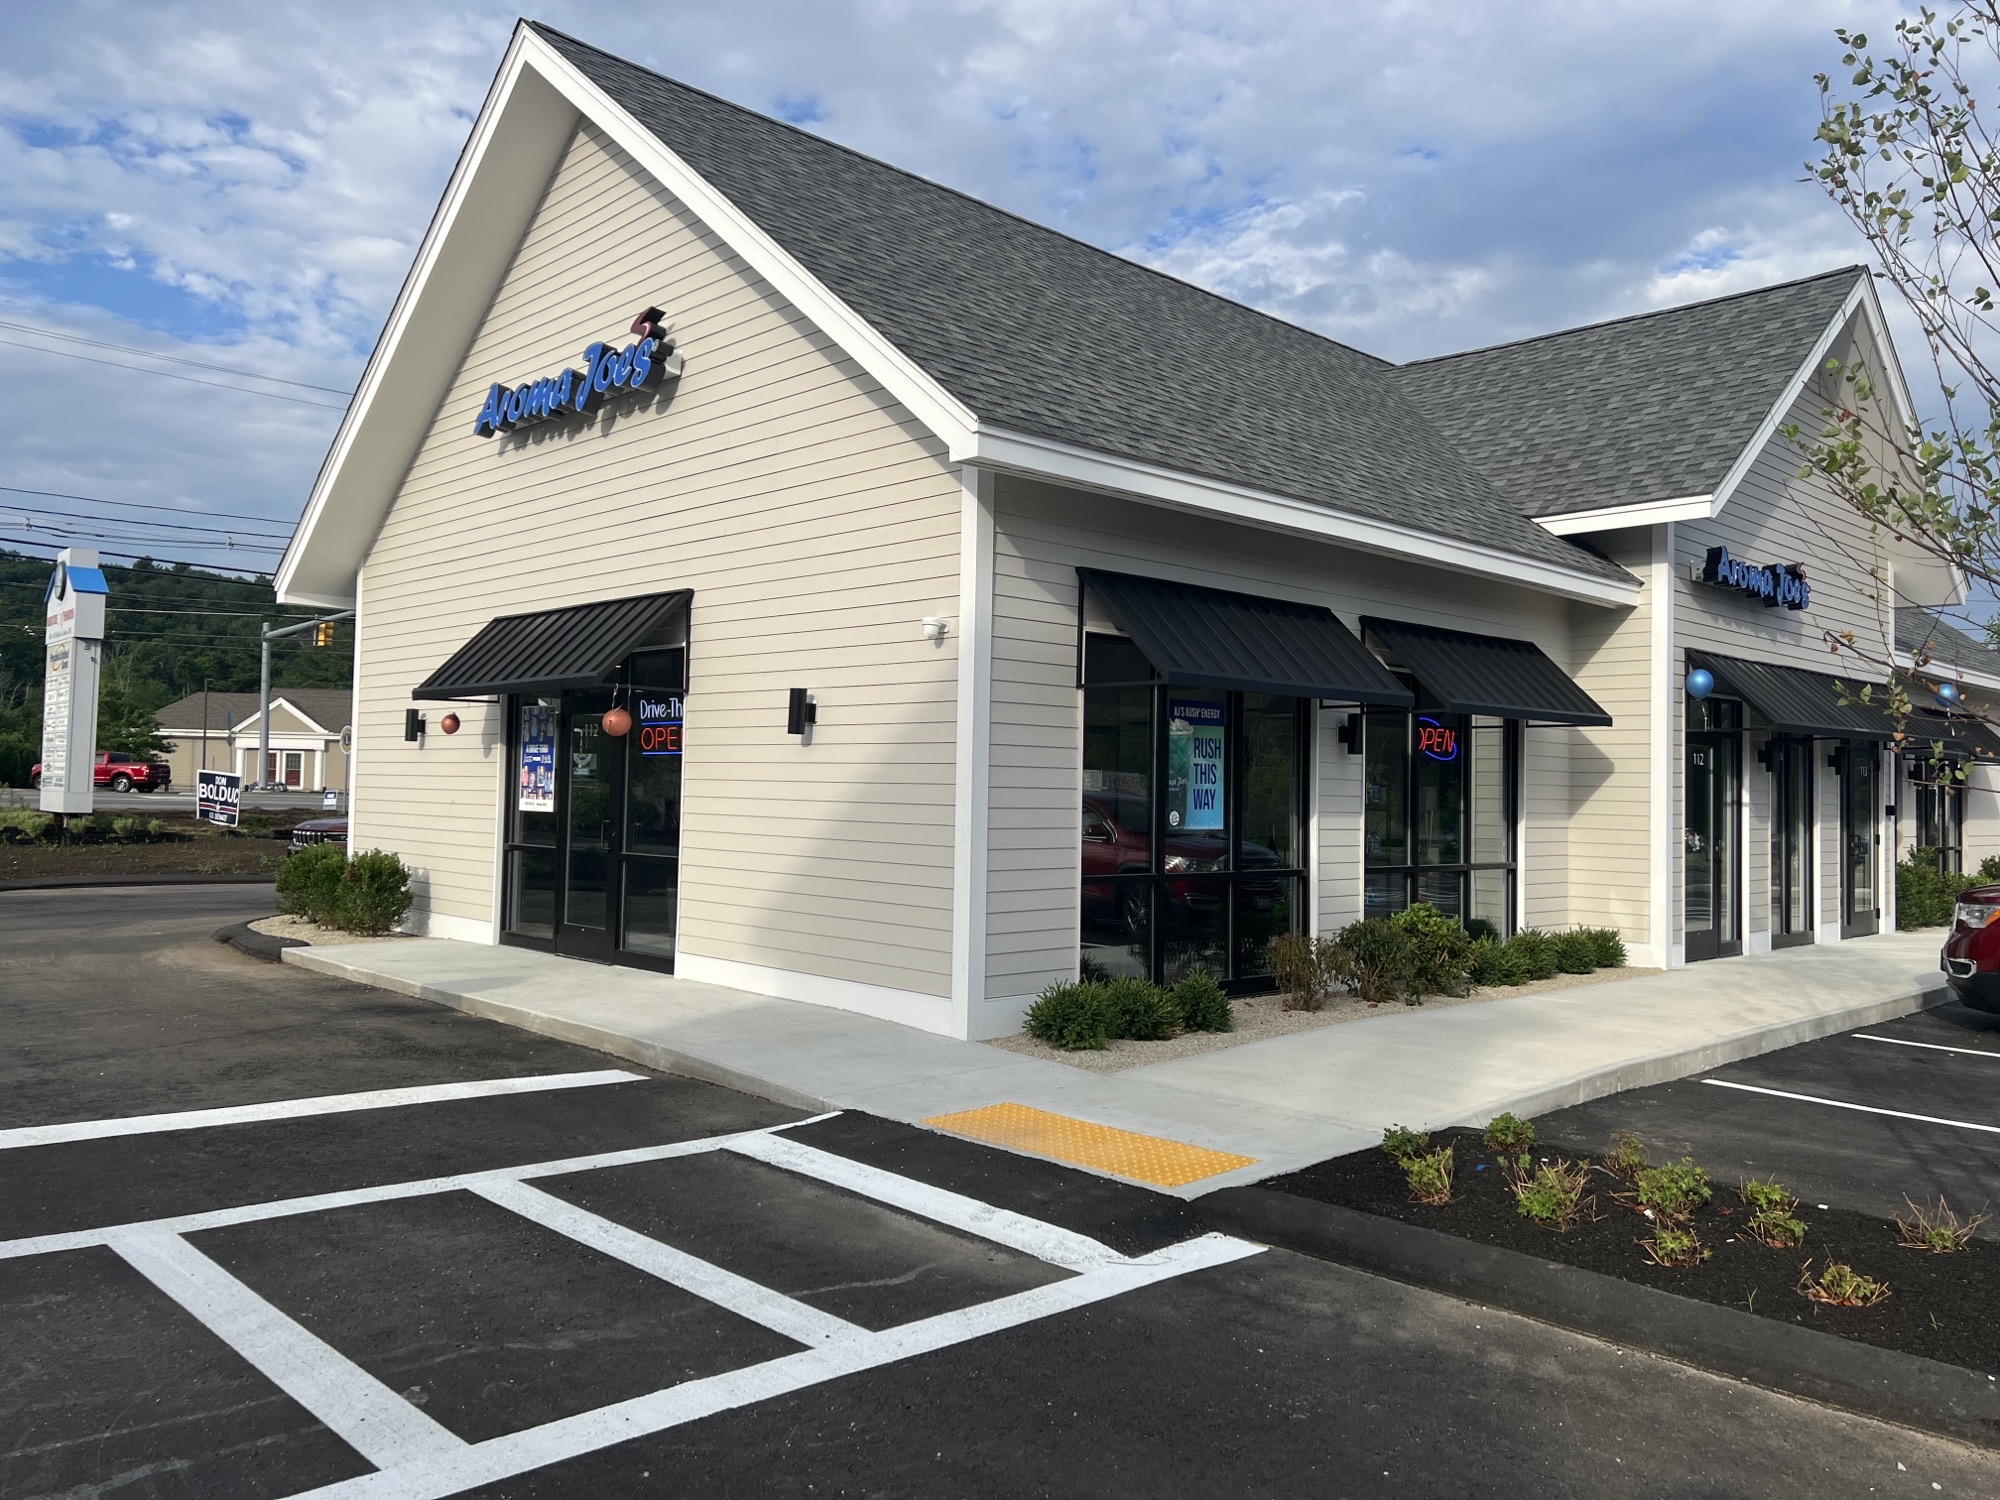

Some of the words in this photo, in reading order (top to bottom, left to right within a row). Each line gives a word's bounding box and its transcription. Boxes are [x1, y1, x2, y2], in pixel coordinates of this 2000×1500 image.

[473, 367, 574, 435] Aroma
[1717, 545, 1775, 597] Aroma
[1201, 708, 1221, 719] ENERGY
[584, 723, 599, 737] 112
[641, 727, 683, 750] OPE
[1193, 737, 1221, 759] RUSH
[1693, 753, 1704, 766] 112
[215, 775, 227, 785] DON
[1193, 763, 1217, 785] THIS
[1860, 766, 1868, 777] 113
[199, 782, 239, 803] BOLDUC
[1193, 788, 1217, 810] WAY
